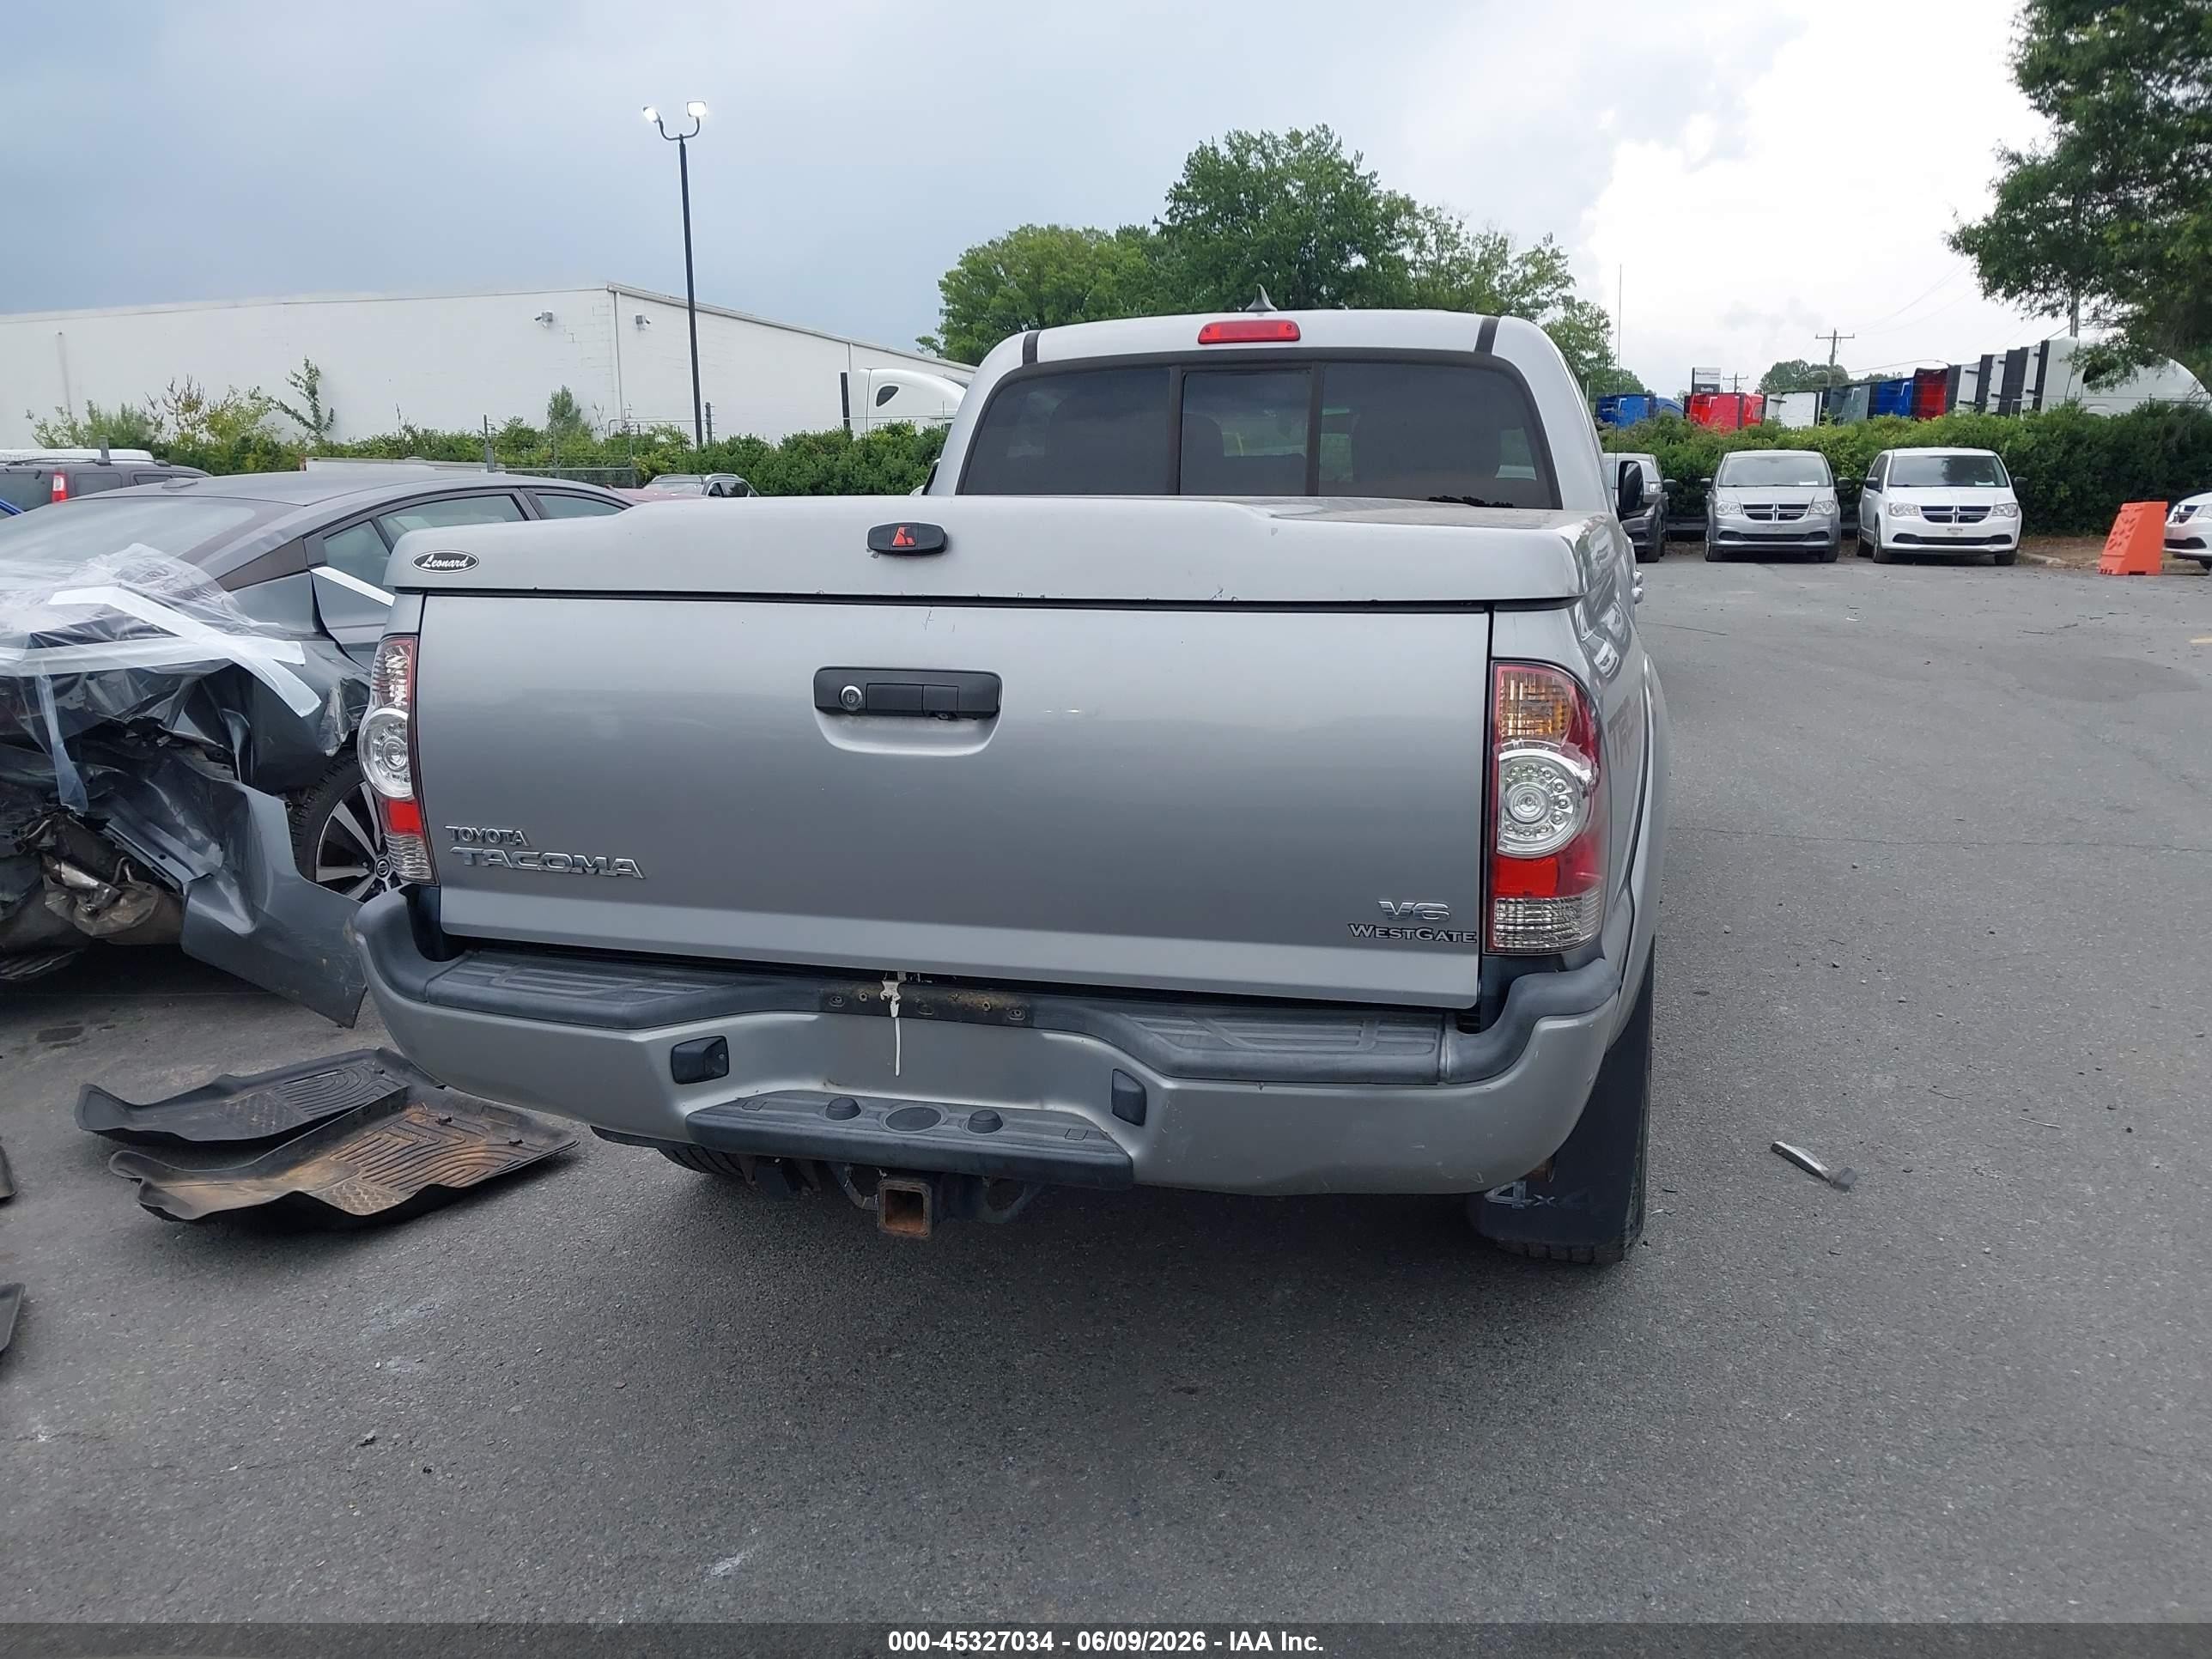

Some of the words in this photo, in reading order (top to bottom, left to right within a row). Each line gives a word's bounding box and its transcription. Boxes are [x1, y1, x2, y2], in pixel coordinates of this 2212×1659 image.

[421, 554, 469, 568] Leonard
[445, 825, 530, 847] TOYOTA
[449, 847, 647, 879] TACOMA
[1377, 900, 1451, 921] V6
